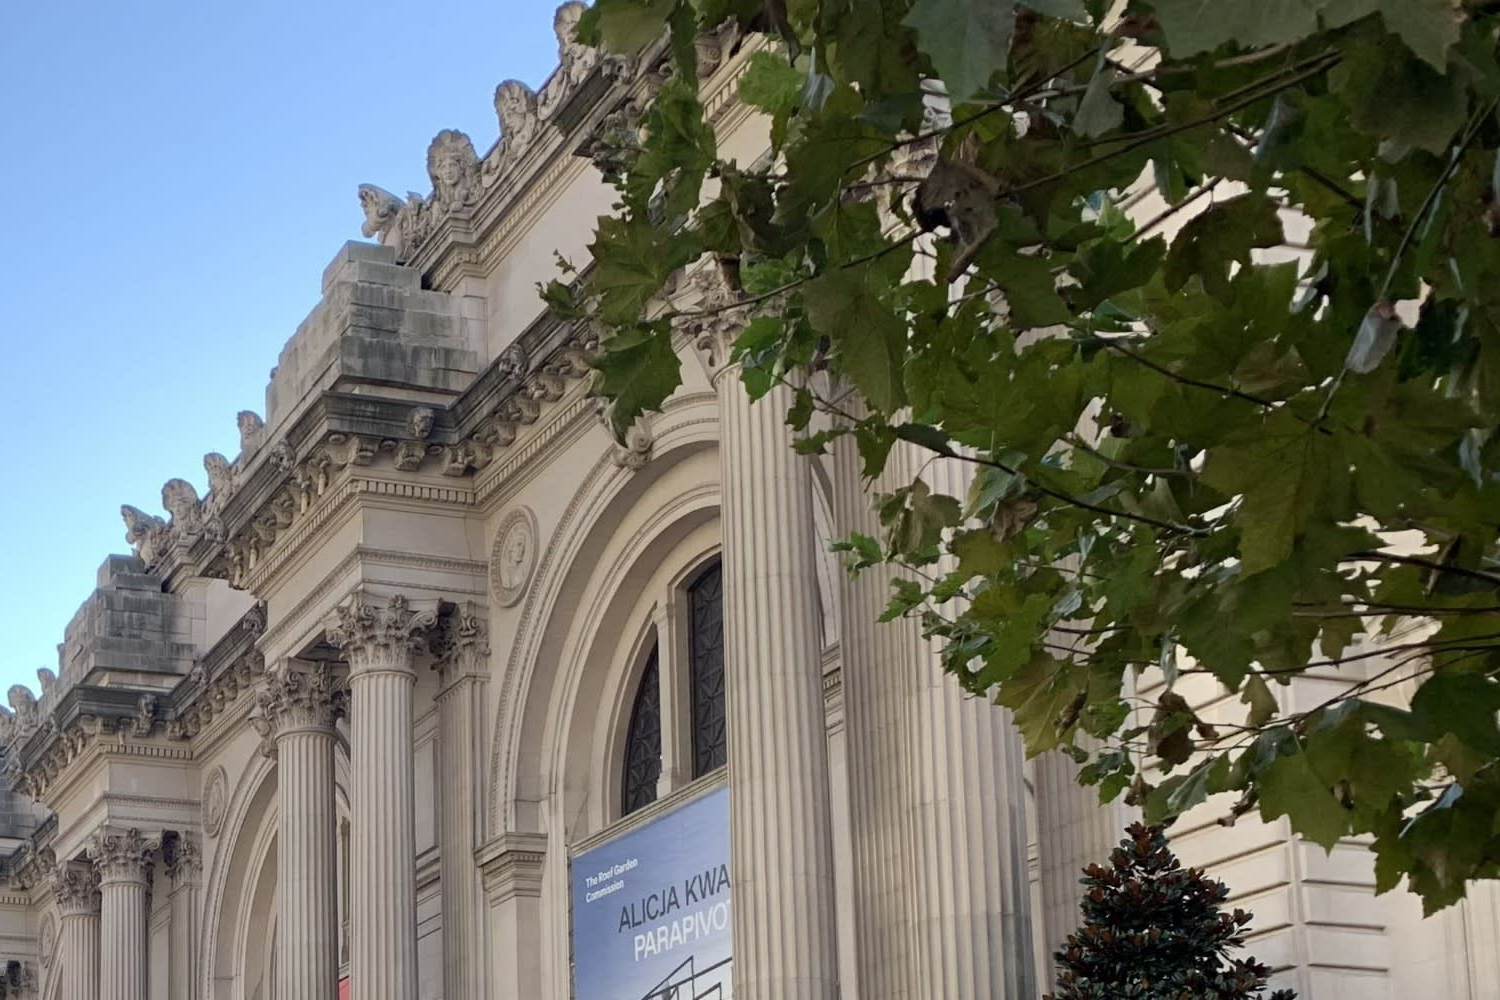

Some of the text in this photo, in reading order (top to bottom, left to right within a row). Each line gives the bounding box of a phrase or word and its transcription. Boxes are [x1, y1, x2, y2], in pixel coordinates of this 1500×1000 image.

[585, 858, 638, 888] The Roof Garden
[585, 879, 625, 903] Commission
[618, 885, 680, 933] ALICJA
